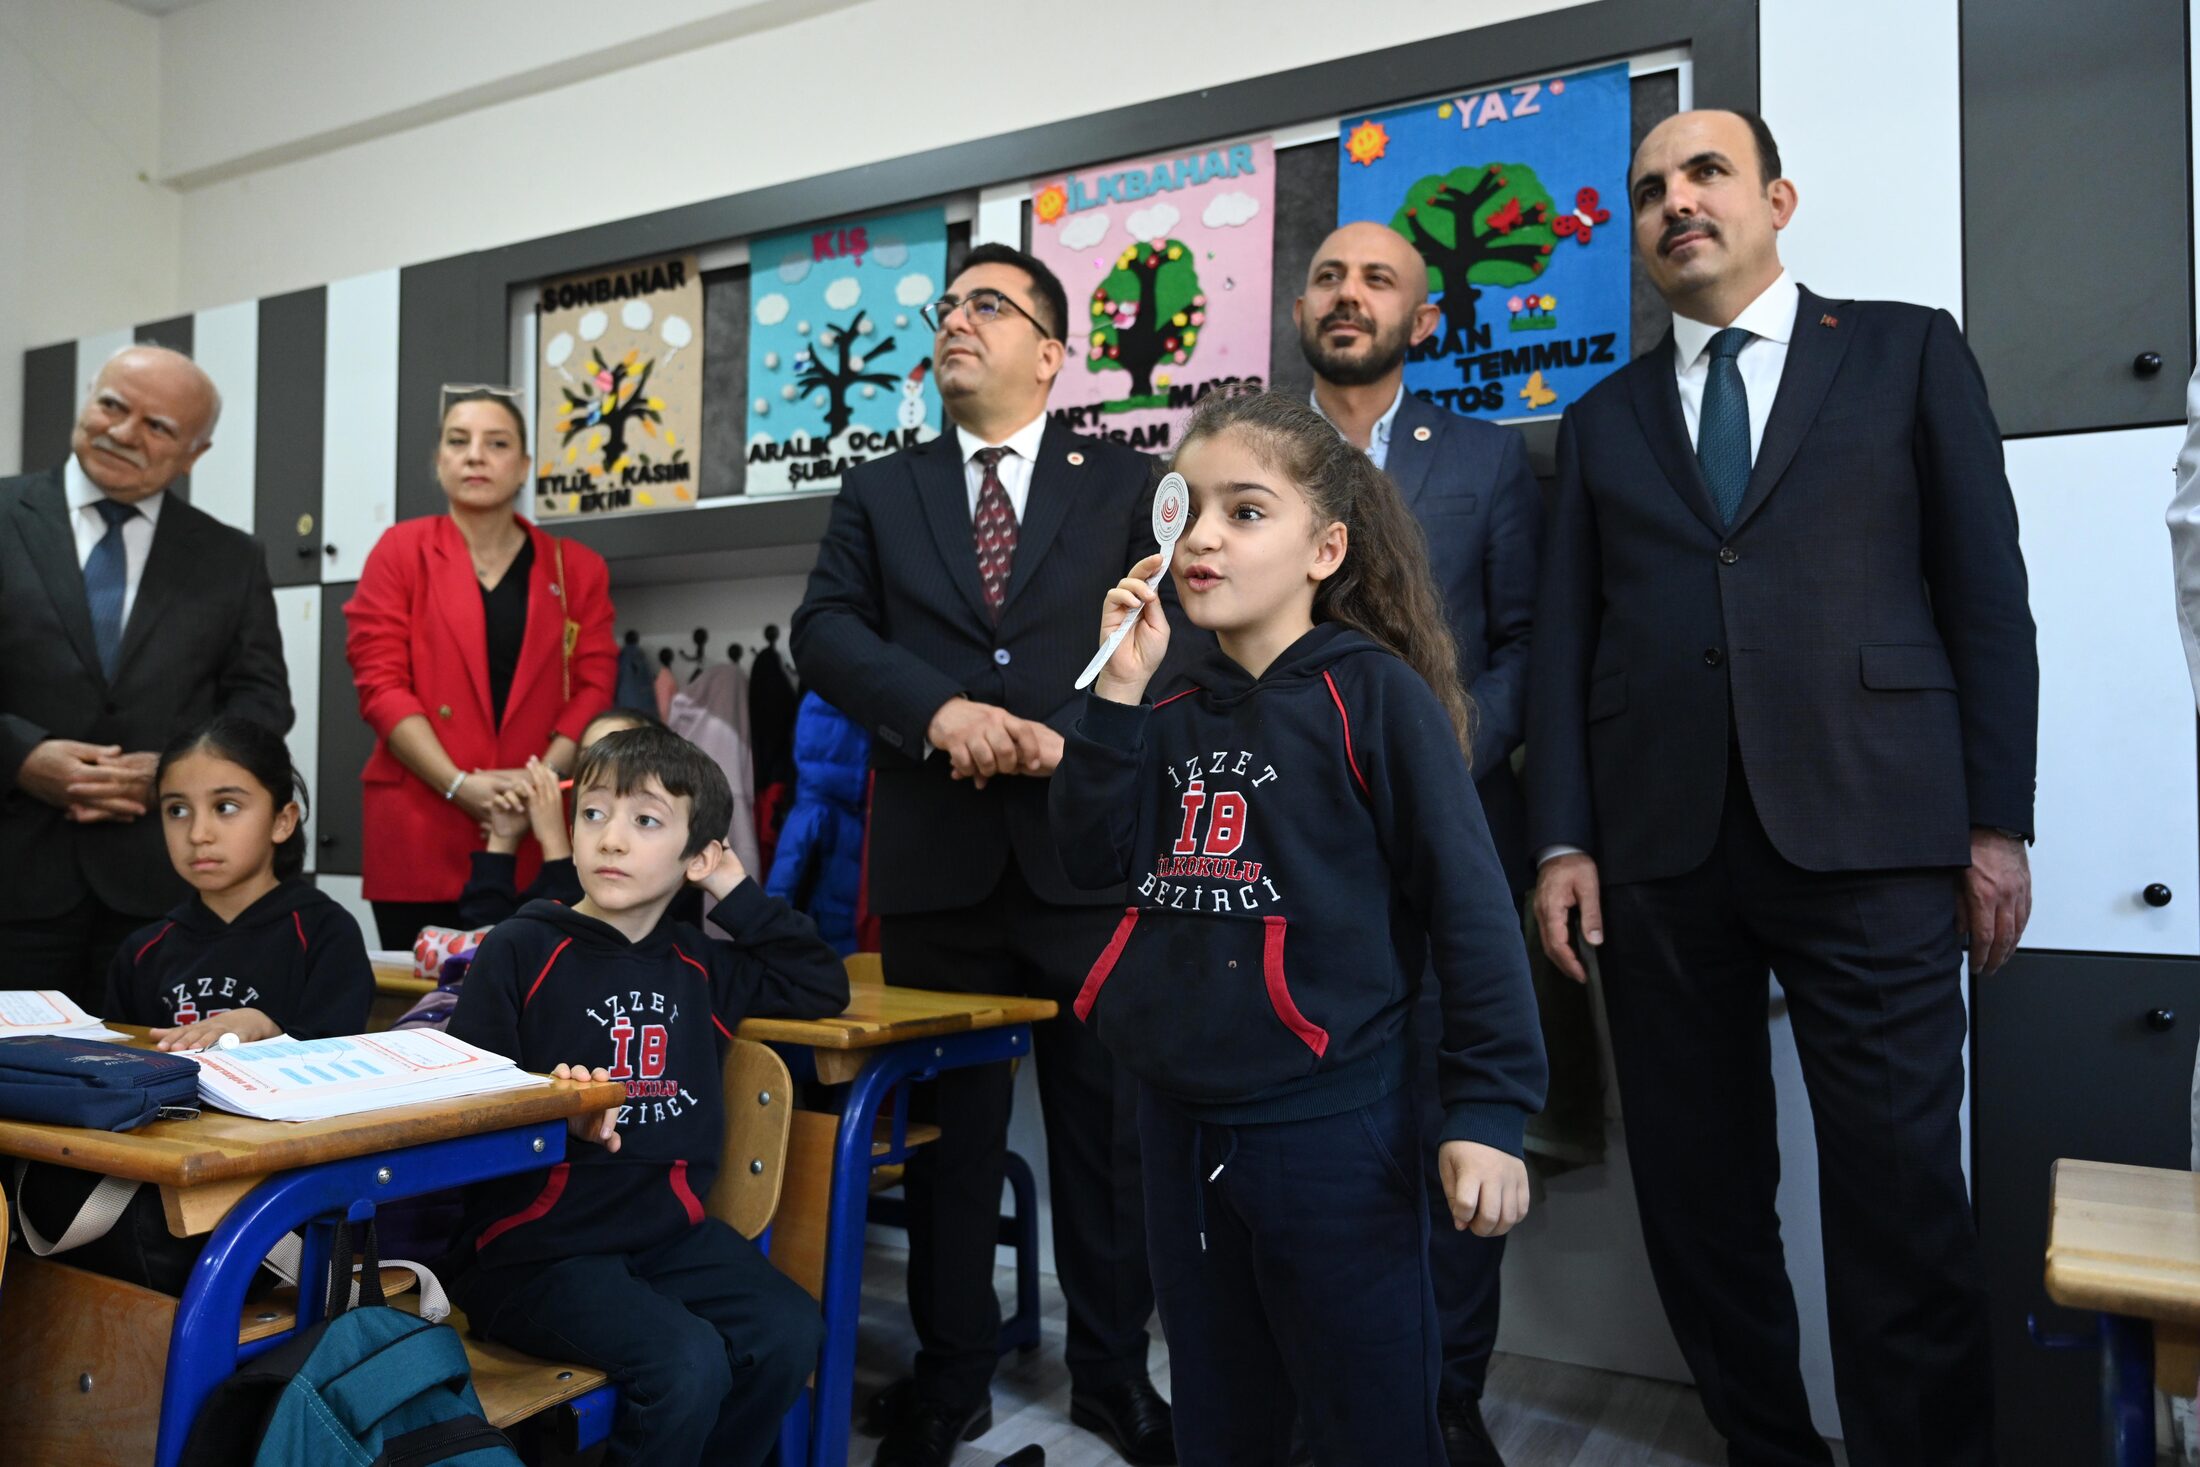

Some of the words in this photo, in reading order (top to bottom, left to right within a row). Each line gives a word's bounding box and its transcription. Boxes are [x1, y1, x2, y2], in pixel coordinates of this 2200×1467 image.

[1454, 83, 1541, 129] YAZ
[1067, 144, 1256, 214] İLKBAHAR
[812, 226, 869, 269] KIŞ
[543, 261, 685, 312] SONBAHAR
[1455, 333, 1616, 383] TEMMUZ
[1049, 401, 1104, 428] ART
[749, 436, 831, 463] ARALIK
[849, 427, 920, 453] OCAK
[537, 468, 597, 494] EYLÜL
[622, 462, 690, 485] KASIM
[580, 482, 631, 512] EKİM
[1168, 751, 1278, 788] İZZET
[1172, 780, 1247, 856] İB
[1155, 853, 1262, 883] İLKOKULU
[1138, 872, 1281, 912] BEZİRCİ
[608, 1016, 668, 1080] İB
[617, 1088, 698, 1124] ZİRCİ
[625, 1080, 678, 1098] OKULU
